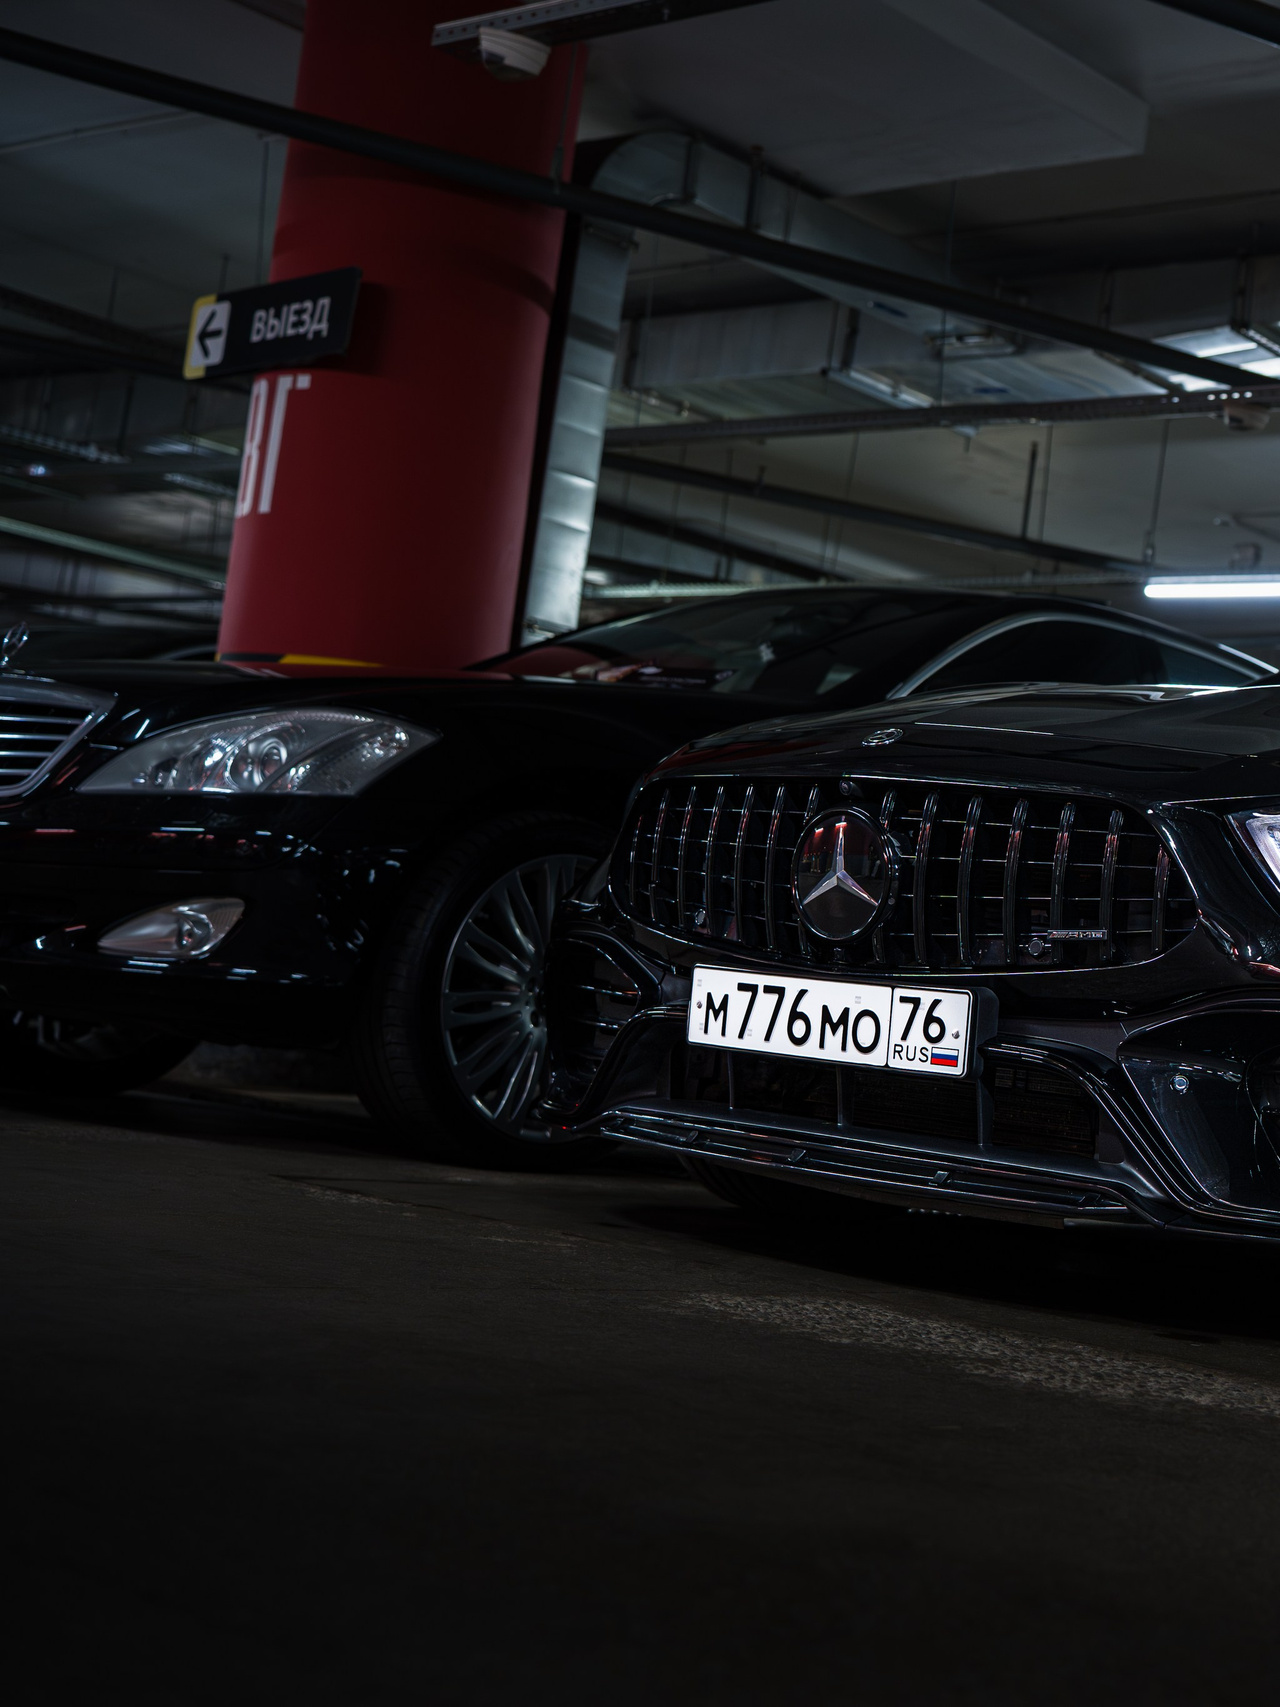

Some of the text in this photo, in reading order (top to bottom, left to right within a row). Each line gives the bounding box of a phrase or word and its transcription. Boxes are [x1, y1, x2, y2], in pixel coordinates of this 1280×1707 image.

[249, 295, 332, 343] ВЫЕЗД
[899, 996, 946, 1043] 76
[892, 1044, 929, 1063] RUS
